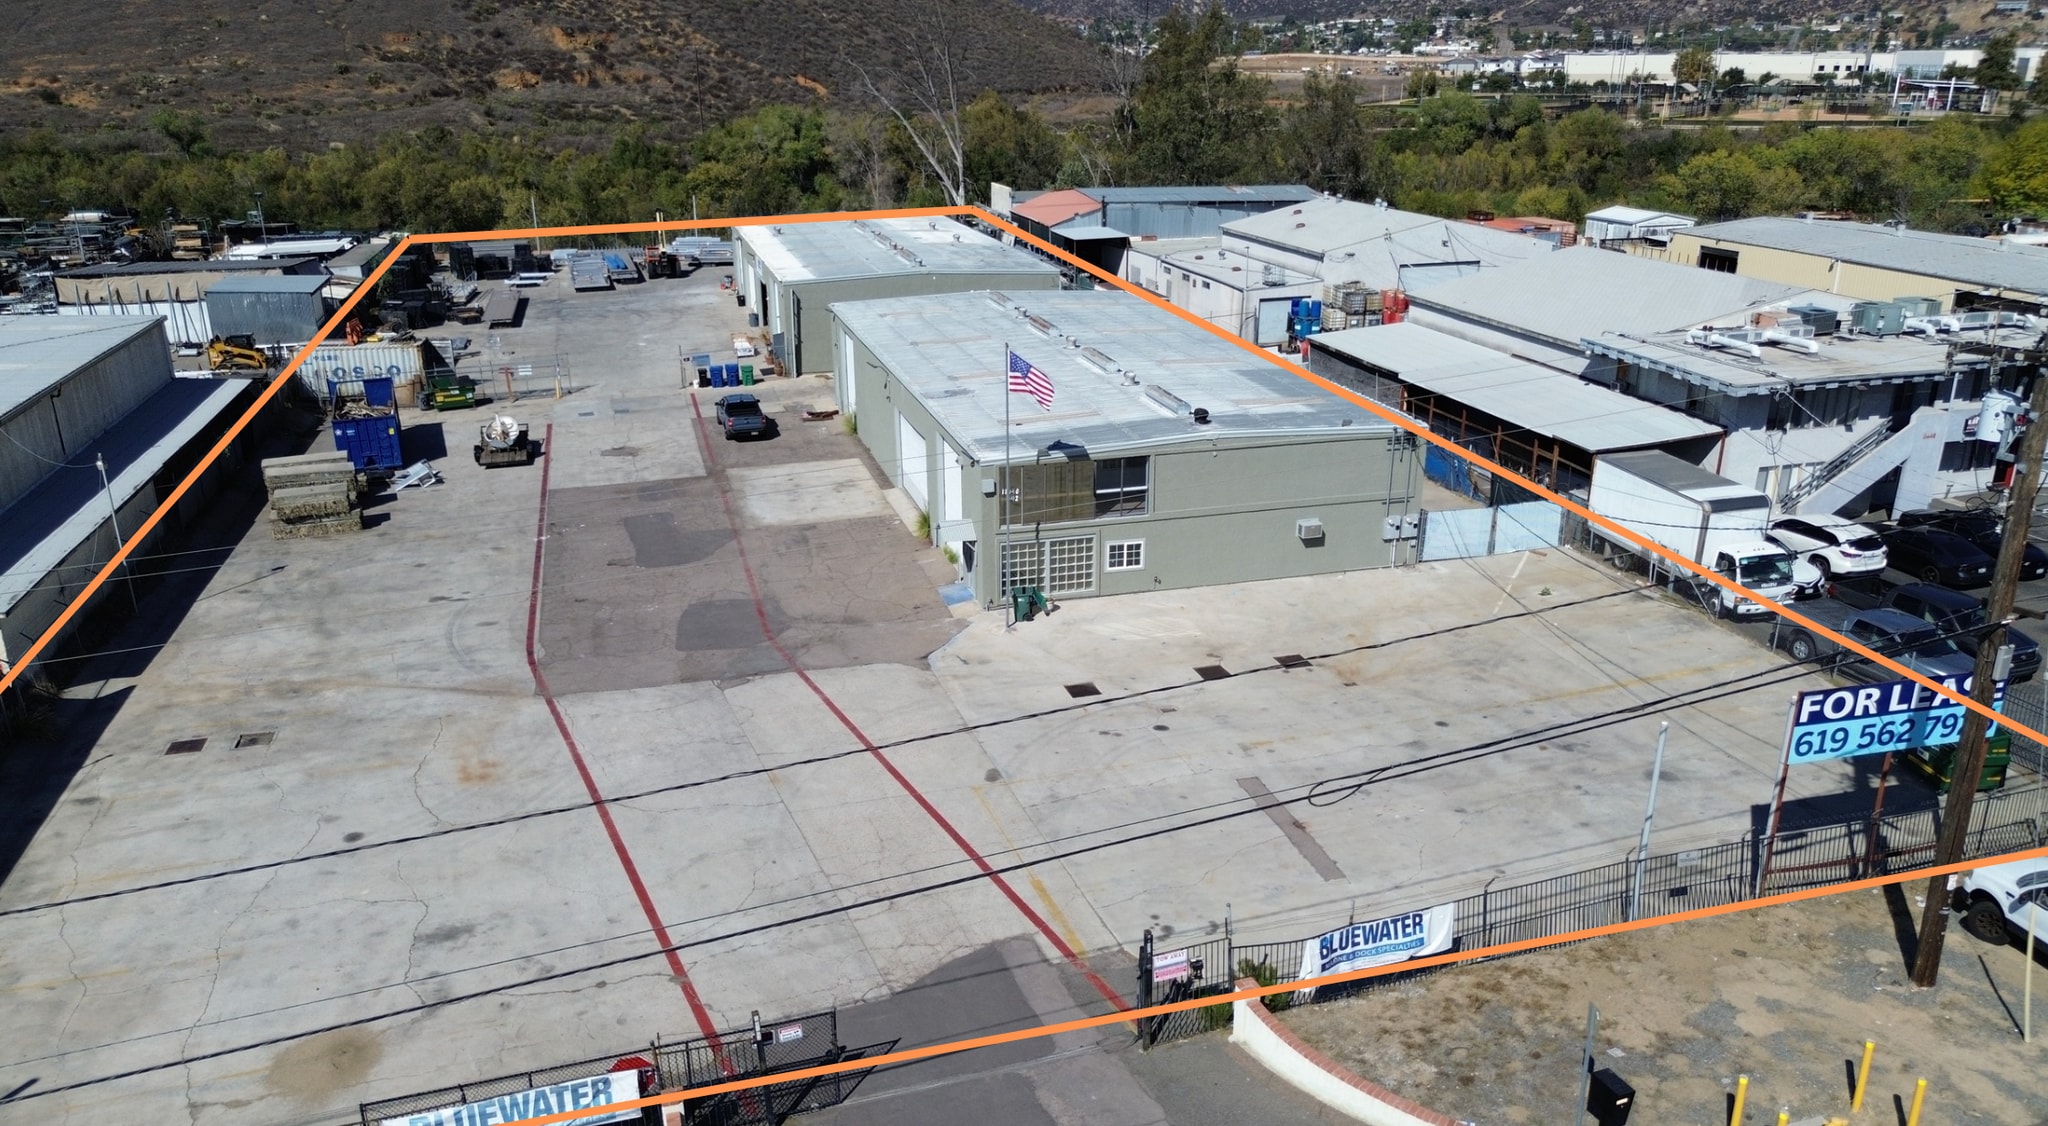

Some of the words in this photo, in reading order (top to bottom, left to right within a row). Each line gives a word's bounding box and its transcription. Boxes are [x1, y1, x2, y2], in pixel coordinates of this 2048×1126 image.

[1799, 687, 1880, 723] FOR
[1888, 676, 2004, 712] LEA
[1794, 727, 1849, 757] 619
[1857, 718, 1916, 749] 562
[1319, 913, 1424, 961] BLUEWATER
[1355, 948, 1377, 958] DOCK
[1377, 940, 1420, 953] SPECIALTIES
[409, 1077, 614, 1126] UEWATER
